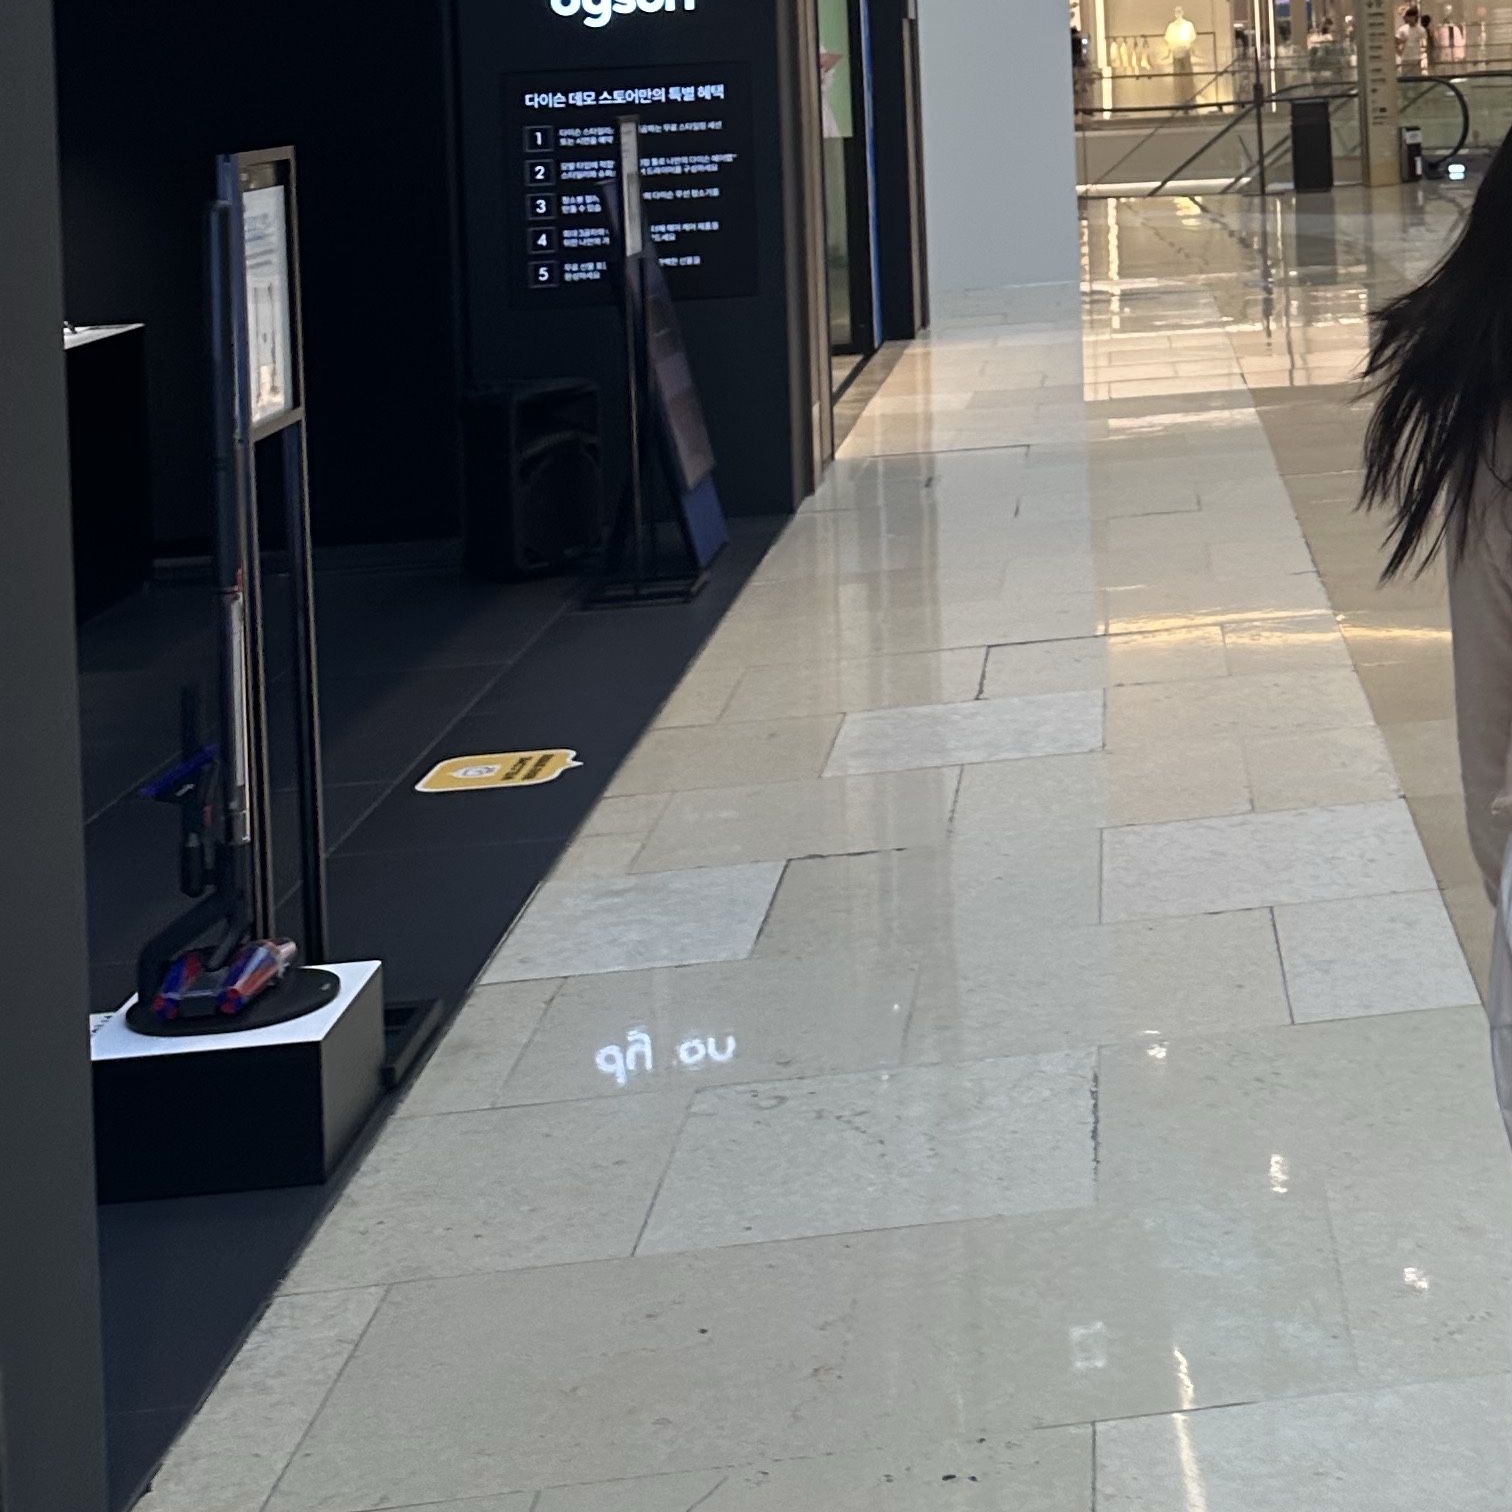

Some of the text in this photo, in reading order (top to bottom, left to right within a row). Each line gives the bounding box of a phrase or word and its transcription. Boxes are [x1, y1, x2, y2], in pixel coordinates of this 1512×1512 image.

[525, 83, 725, 109] 다이슨 데모 스토어만의 특별 혜택
[534, 131, 542, 146] 1
[534, 165, 546, 180] 2
[535, 199, 547, 214] 3
[536, 233, 548, 248] 4
[537, 266, 549, 281] 5
